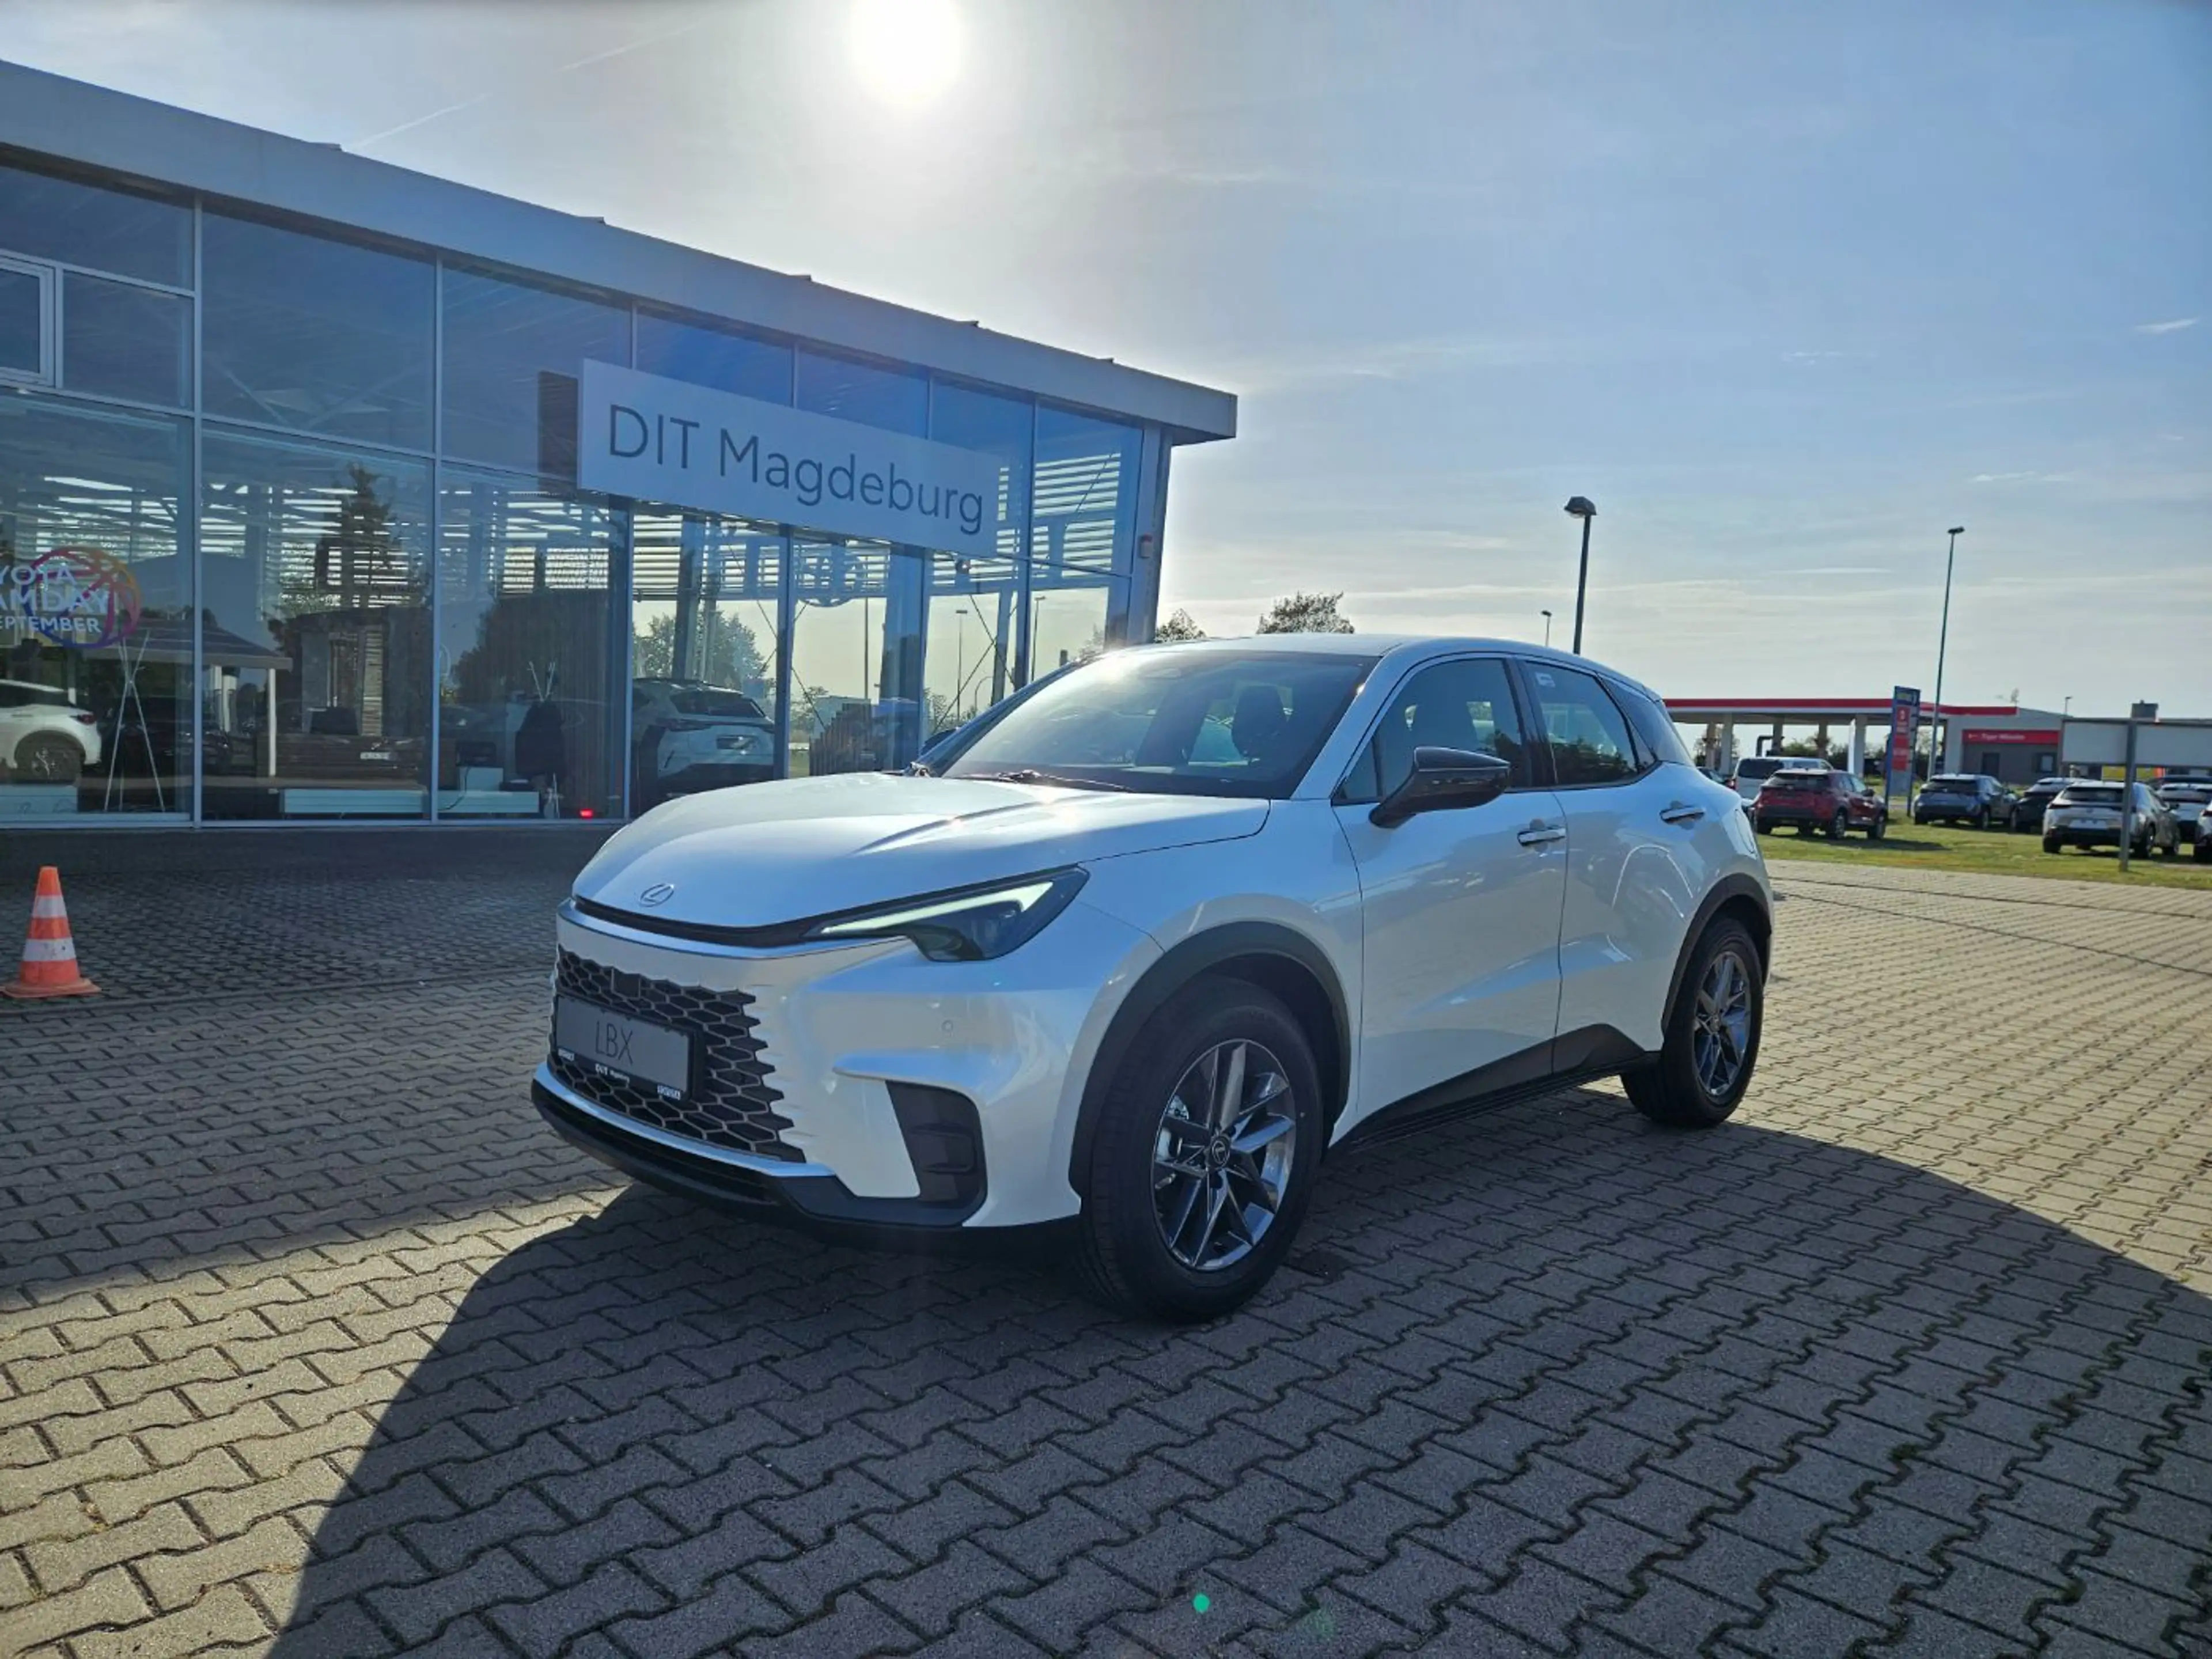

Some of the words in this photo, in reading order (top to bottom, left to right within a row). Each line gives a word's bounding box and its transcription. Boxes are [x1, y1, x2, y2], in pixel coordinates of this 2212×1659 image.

[610, 404, 700, 469] DIT
[720, 428, 983, 535] Magdeburg
[595, 1021, 633, 1065] LBX
